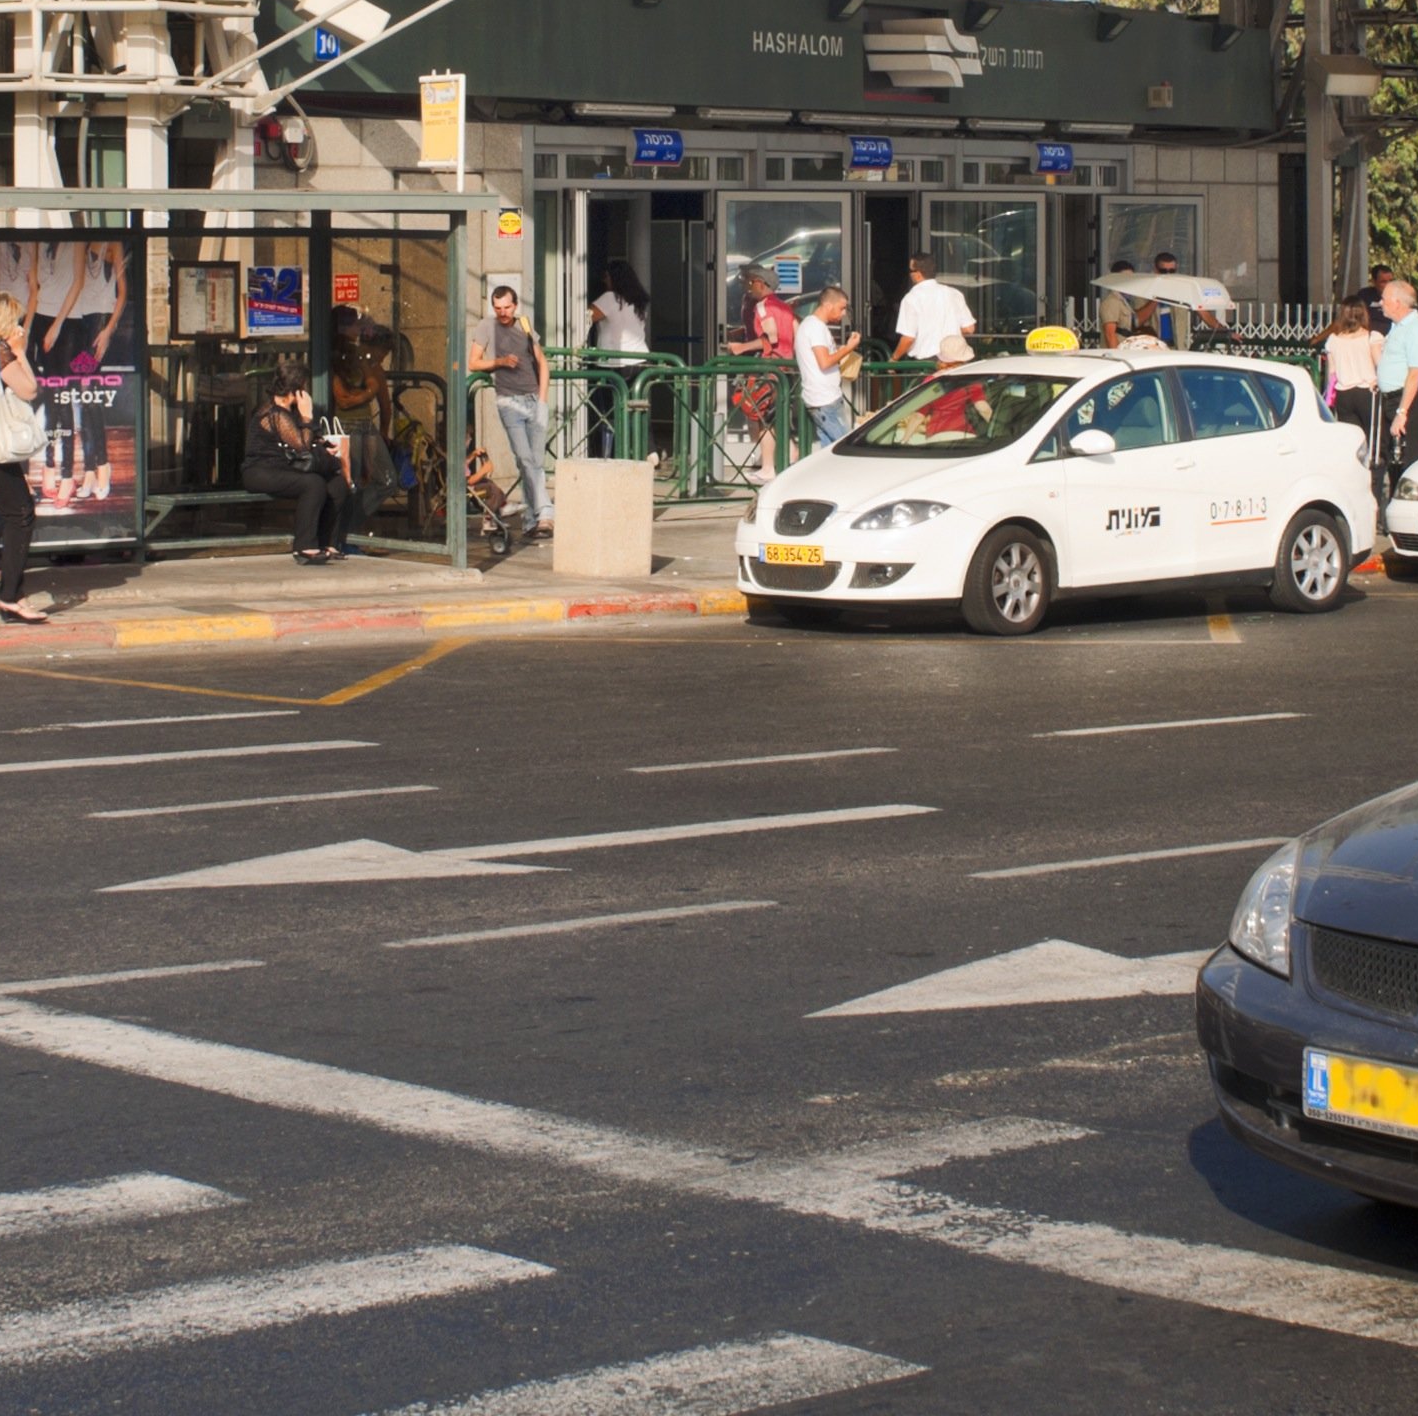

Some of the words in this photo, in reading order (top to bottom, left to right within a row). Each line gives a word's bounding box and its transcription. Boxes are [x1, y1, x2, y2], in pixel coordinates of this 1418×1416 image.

[320, 34, 336, 54] 10
[753, 31, 843, 57] HASHALOM
[1012, 48, 1044, 70] תחנת
[644, 134, 673, 146] כניסה
[855, 140, 877, 151] כניסה
[1043, 146, 1065, 157] כניסה
[252, 268, 298, 305] 32
